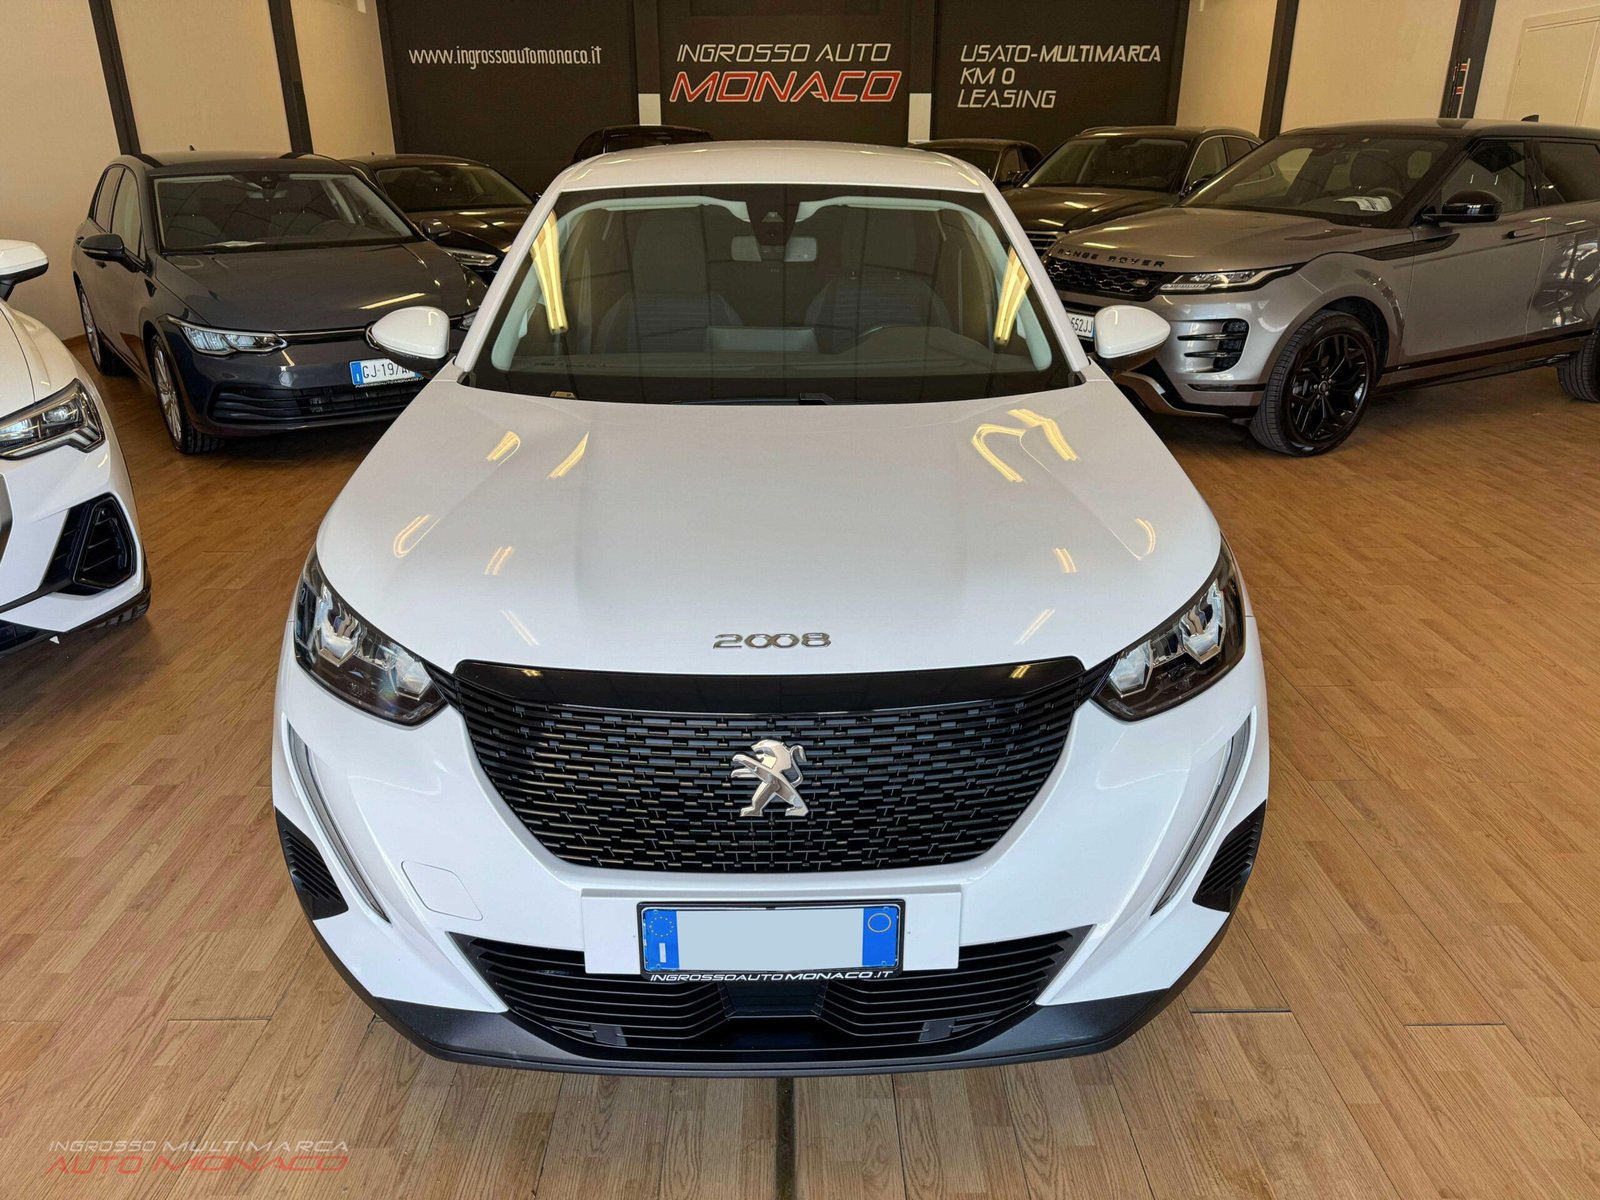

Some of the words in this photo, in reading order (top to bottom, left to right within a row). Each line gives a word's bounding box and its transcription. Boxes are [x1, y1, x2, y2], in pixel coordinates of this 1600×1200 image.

[408, 45, 602, 70] www.ingrossoautomonaco.it
[676, 43, 811, 63] INGROSSO
[815, 43, 892, 62] AUTO
[960, 44, 1162, 63] USATO-MULTIMARCA
[960, 67, 998, 85] KM
[669, 70, 903, 103] MONACO
[957, 89, 1057, 108] LEASING
[1057, 248, 1100, 261] RANGE
[1107, 255, 1166, 268] ROVER
[713, 632, 832, 649] 2008
